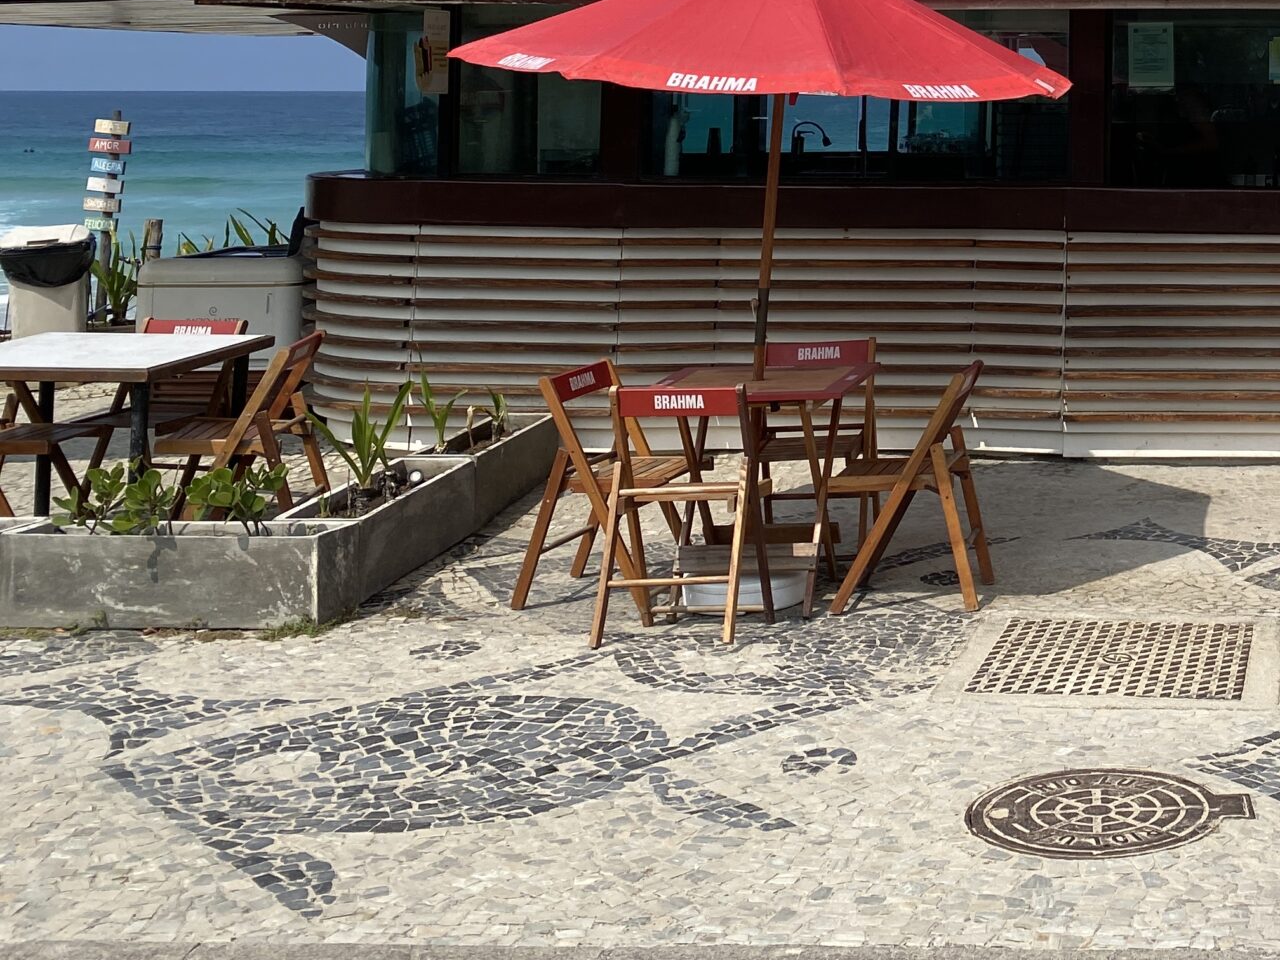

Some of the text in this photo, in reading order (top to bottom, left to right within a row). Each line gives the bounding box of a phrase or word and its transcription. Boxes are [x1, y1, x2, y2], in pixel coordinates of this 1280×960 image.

[666, 72, 758, 91] BRAHMA
[902, 84, 980, 99] BRAHMA
[95, 141, 120, 151] AMOR
[173, 325, 212, 335] BRAHMA
[797, 347, 841, 361] BRAHMA
[568, 371, 596, 391] BRAHMA
[654, 394, 705, 410] BRAHMA
[1031, 776, 1082, 793] RIO
